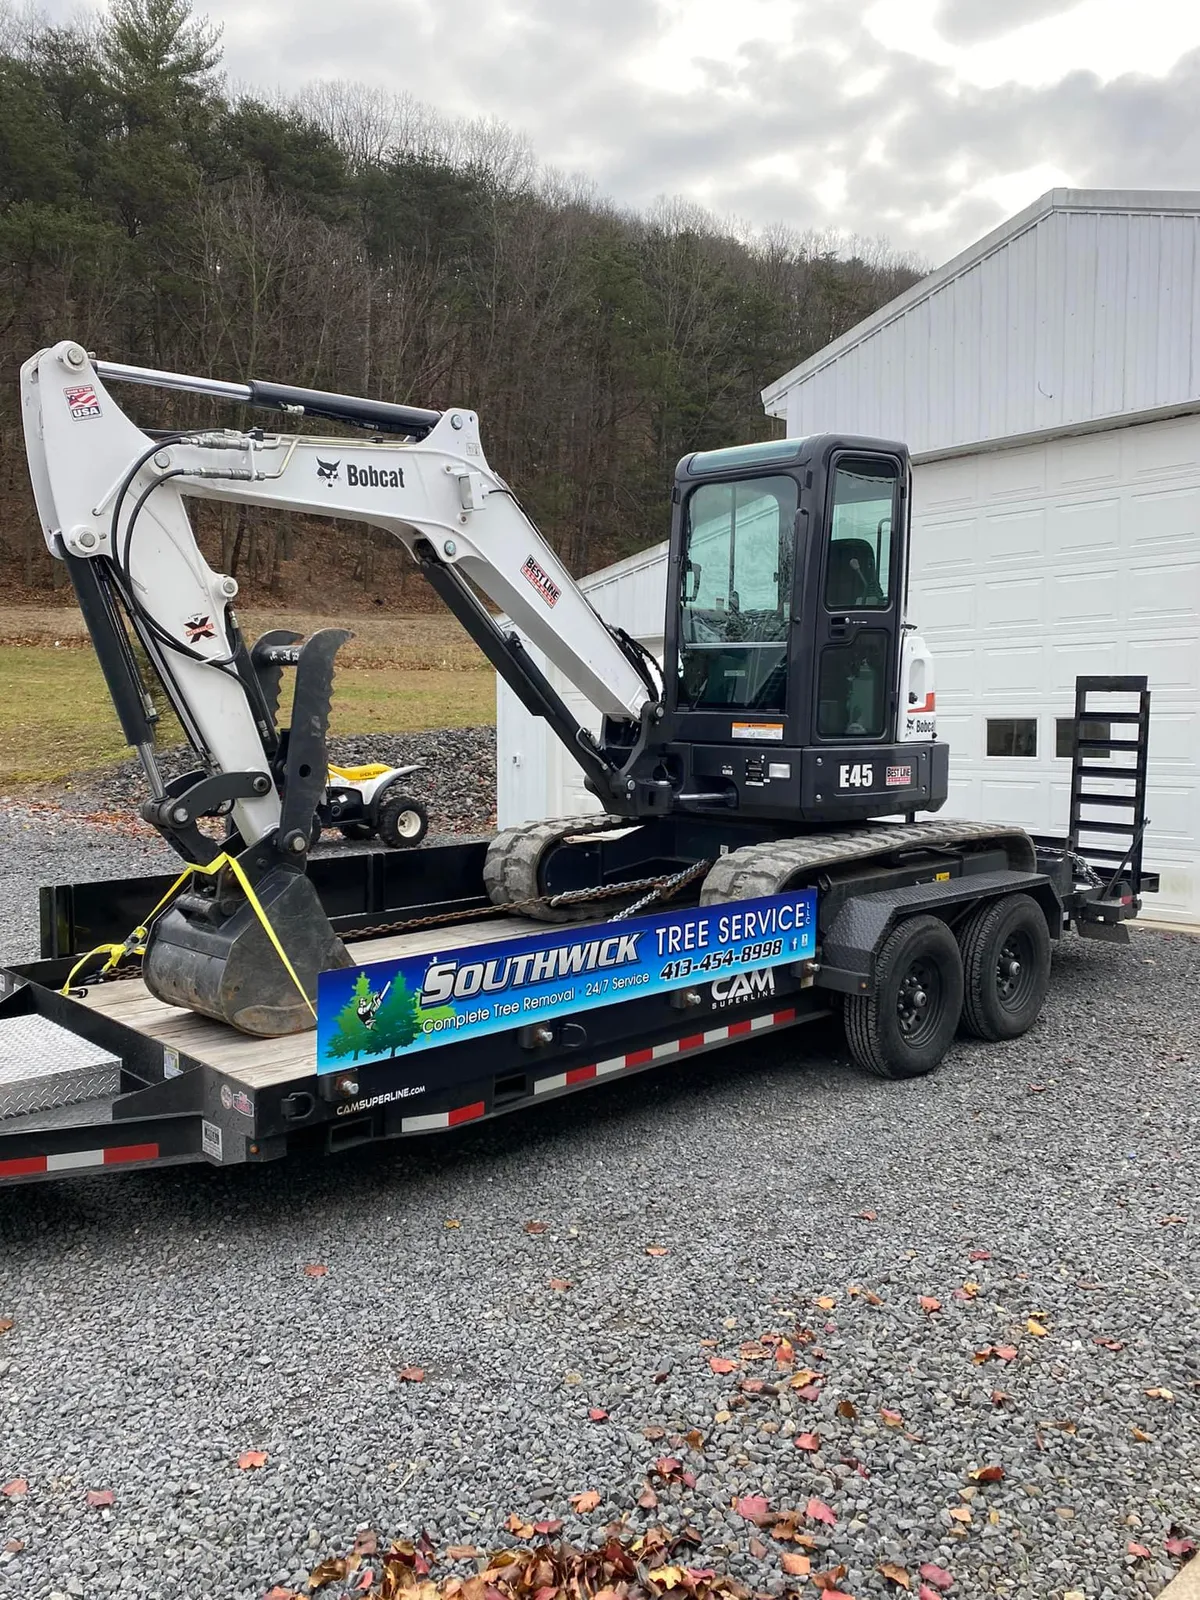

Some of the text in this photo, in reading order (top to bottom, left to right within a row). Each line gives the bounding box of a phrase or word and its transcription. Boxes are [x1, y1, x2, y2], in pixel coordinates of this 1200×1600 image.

[73, 407, 99, 417] USA
[346, 464, 405, 488] Bobcat
[526, 557, 545, 581] BEST
[543, 578, 560, 600] LINE
[916, 719, 936, 733] Bobca
[840, 764, 873, 788] E45
[887, 768, 911, 777] BEST LINE
[421, 902, 805, 1006] SOUTHWICK TREE SERVICE
[659, 938, 784, 981] 413-454-8998
[711, 967, 775, 1001] CAM
[422, 972, 650, 1034] Complete Tree Removal 24/7 Service
[711, 988, 776, 1010] SUPERLINE
[336, 1085, 426, 1115] CAMSUPERLINE.COM
